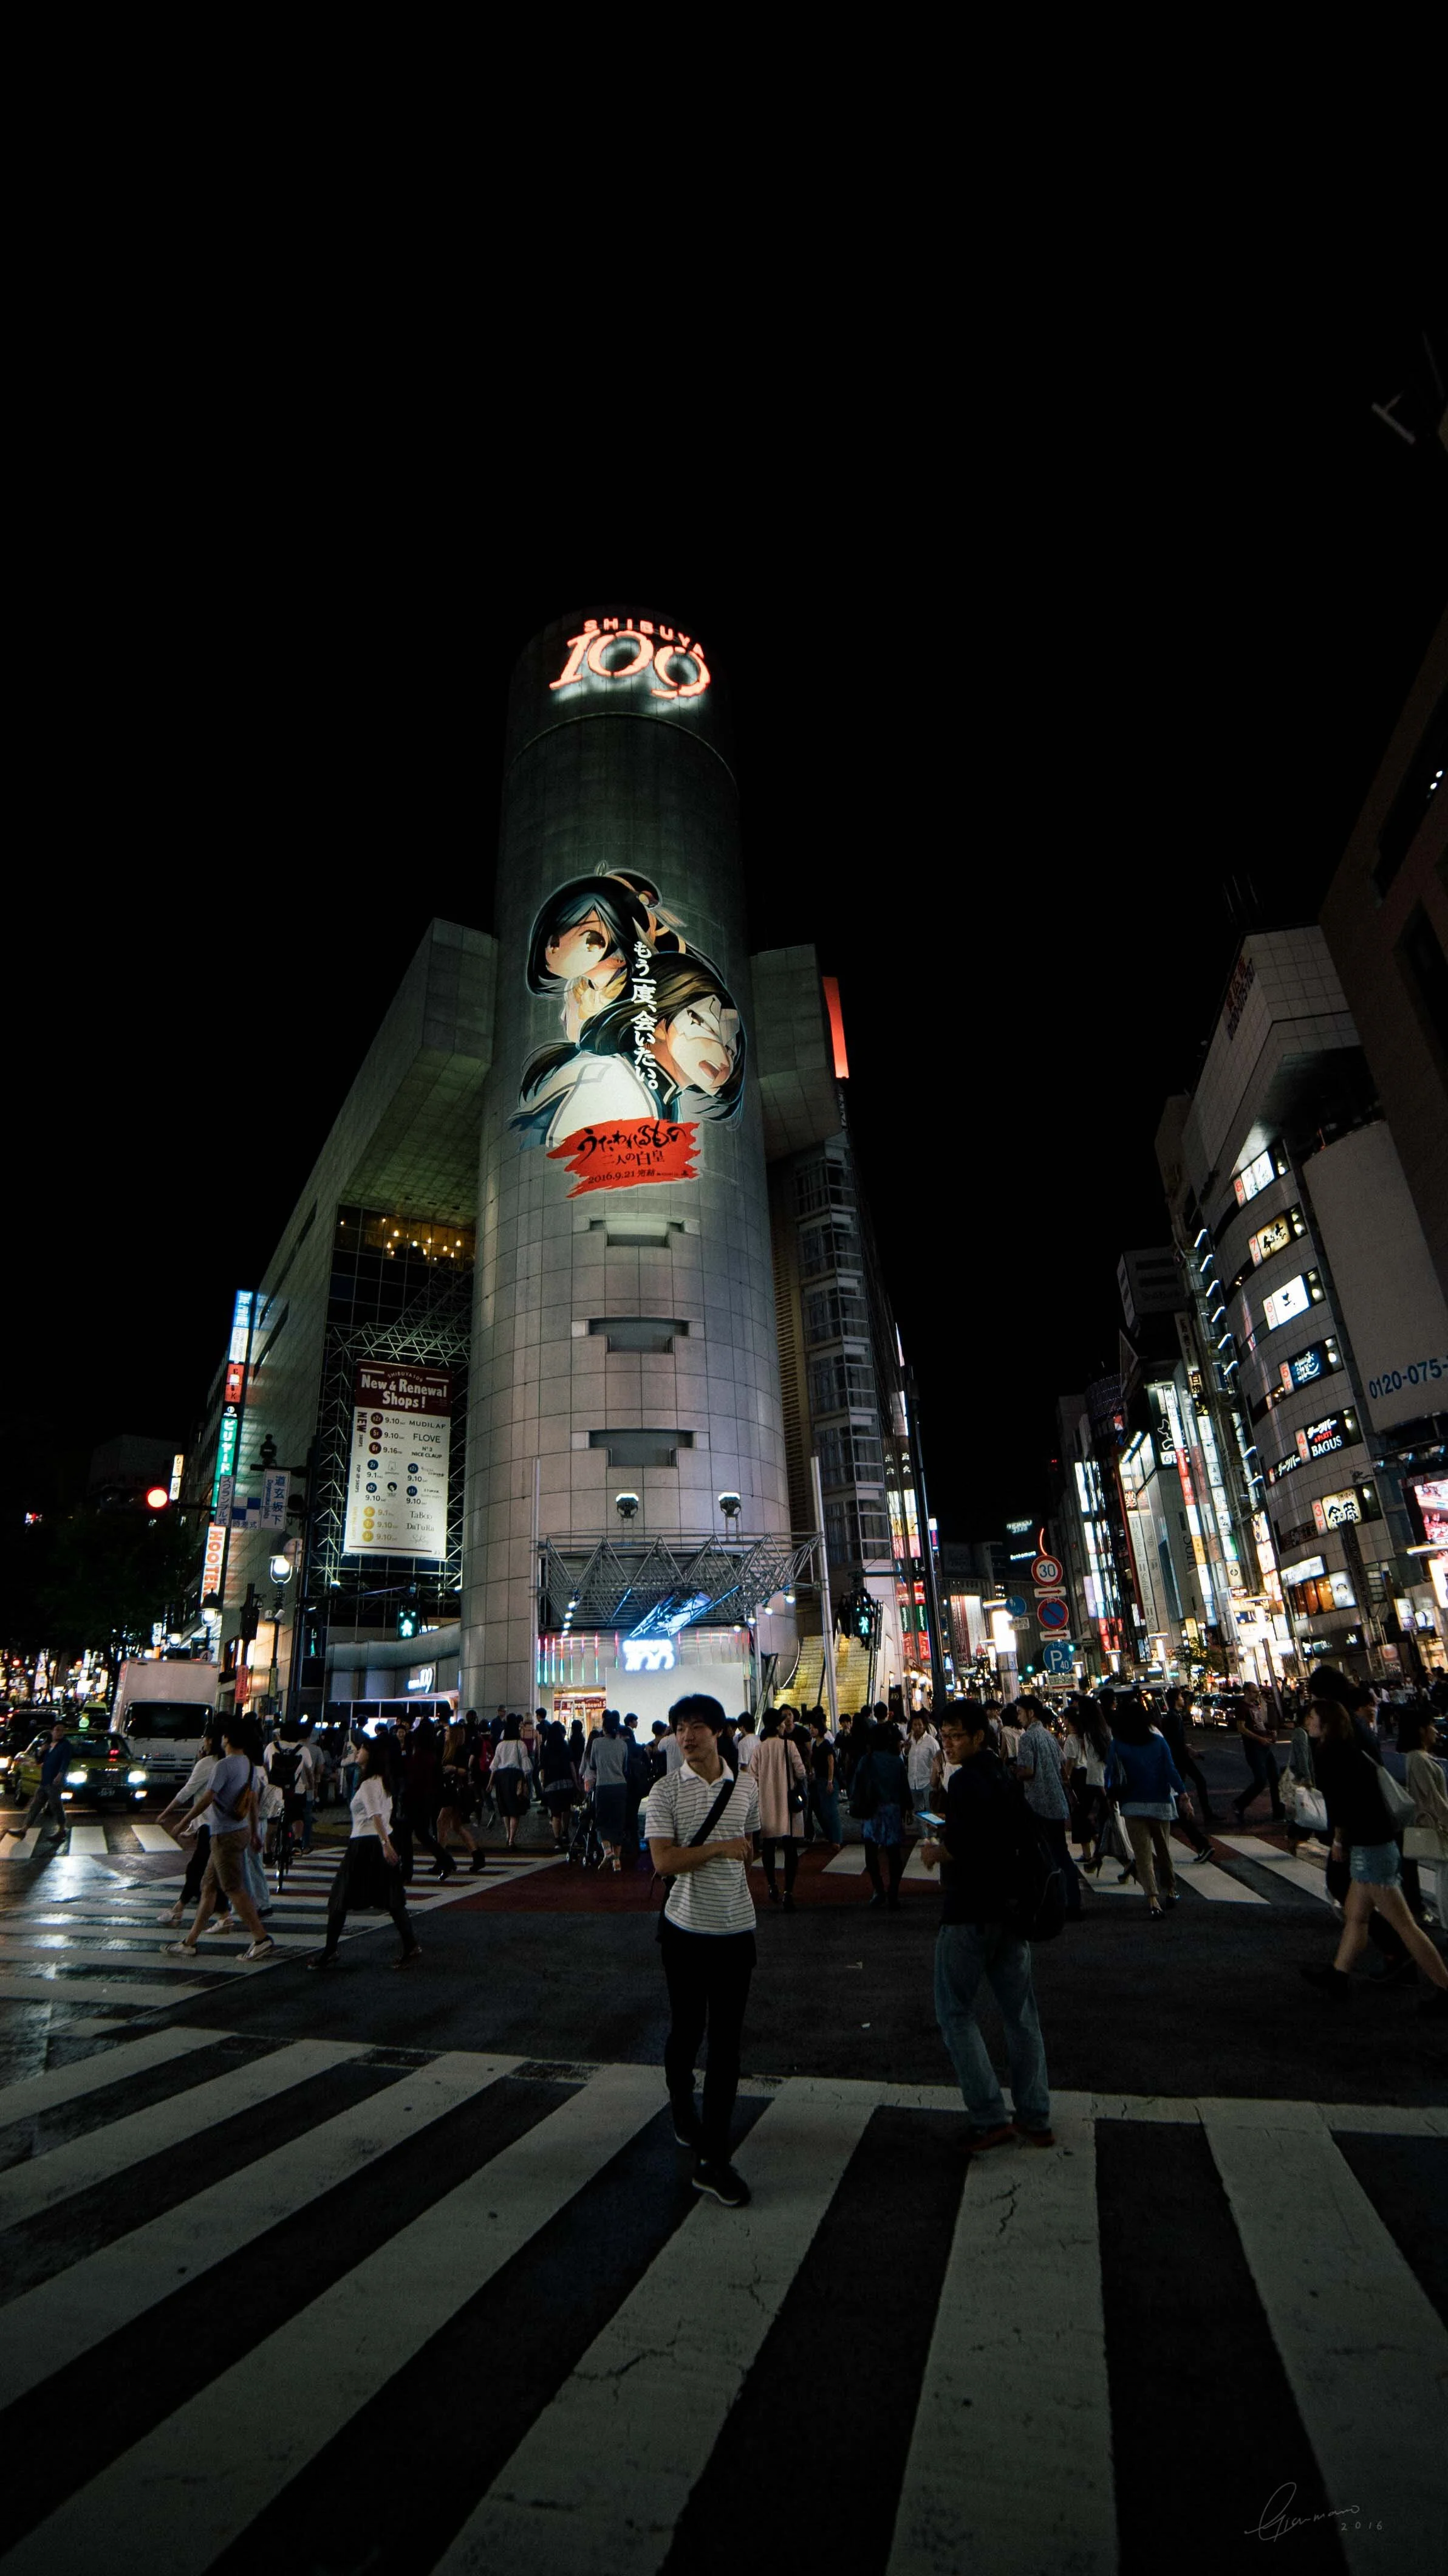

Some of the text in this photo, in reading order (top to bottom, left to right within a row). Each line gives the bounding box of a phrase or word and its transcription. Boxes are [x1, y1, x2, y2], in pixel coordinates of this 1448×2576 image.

[584, 618, 705, 659] SHIBUYA
[549, 629, 710, 699] 109
[630, 940, 659, 1090] もう一度、会いたい。
[577, 1120, 686, 1165] うたわれるもの
[602, 1149, 665, 1166] 二人の白皇
[588, 1170, 635, 1184] 2016.9.21
[361, 1374, 448, 1398] New & Renewal
[357, 1412, 367, 1433] NEW
[1306, 1418, 1337, 1439] ダーツバー
[220, 1420, 235, 1473] ビリヤード
[413, 1433, 442, 1443] FLOVE
[1311, 1435, 1342, 1458] BAGUS
[219, 1476, 231, 1526] スクランブル式
[272, 1475, 286, 1526] 道玄坂下
[202, 1530, 224, 1603] HOOTER
[1039, 1563, 1056, 1578] 30
[1141, 1572, 1151, 1601] SoftBank
[1050, 1650, 1062, 1671] P
